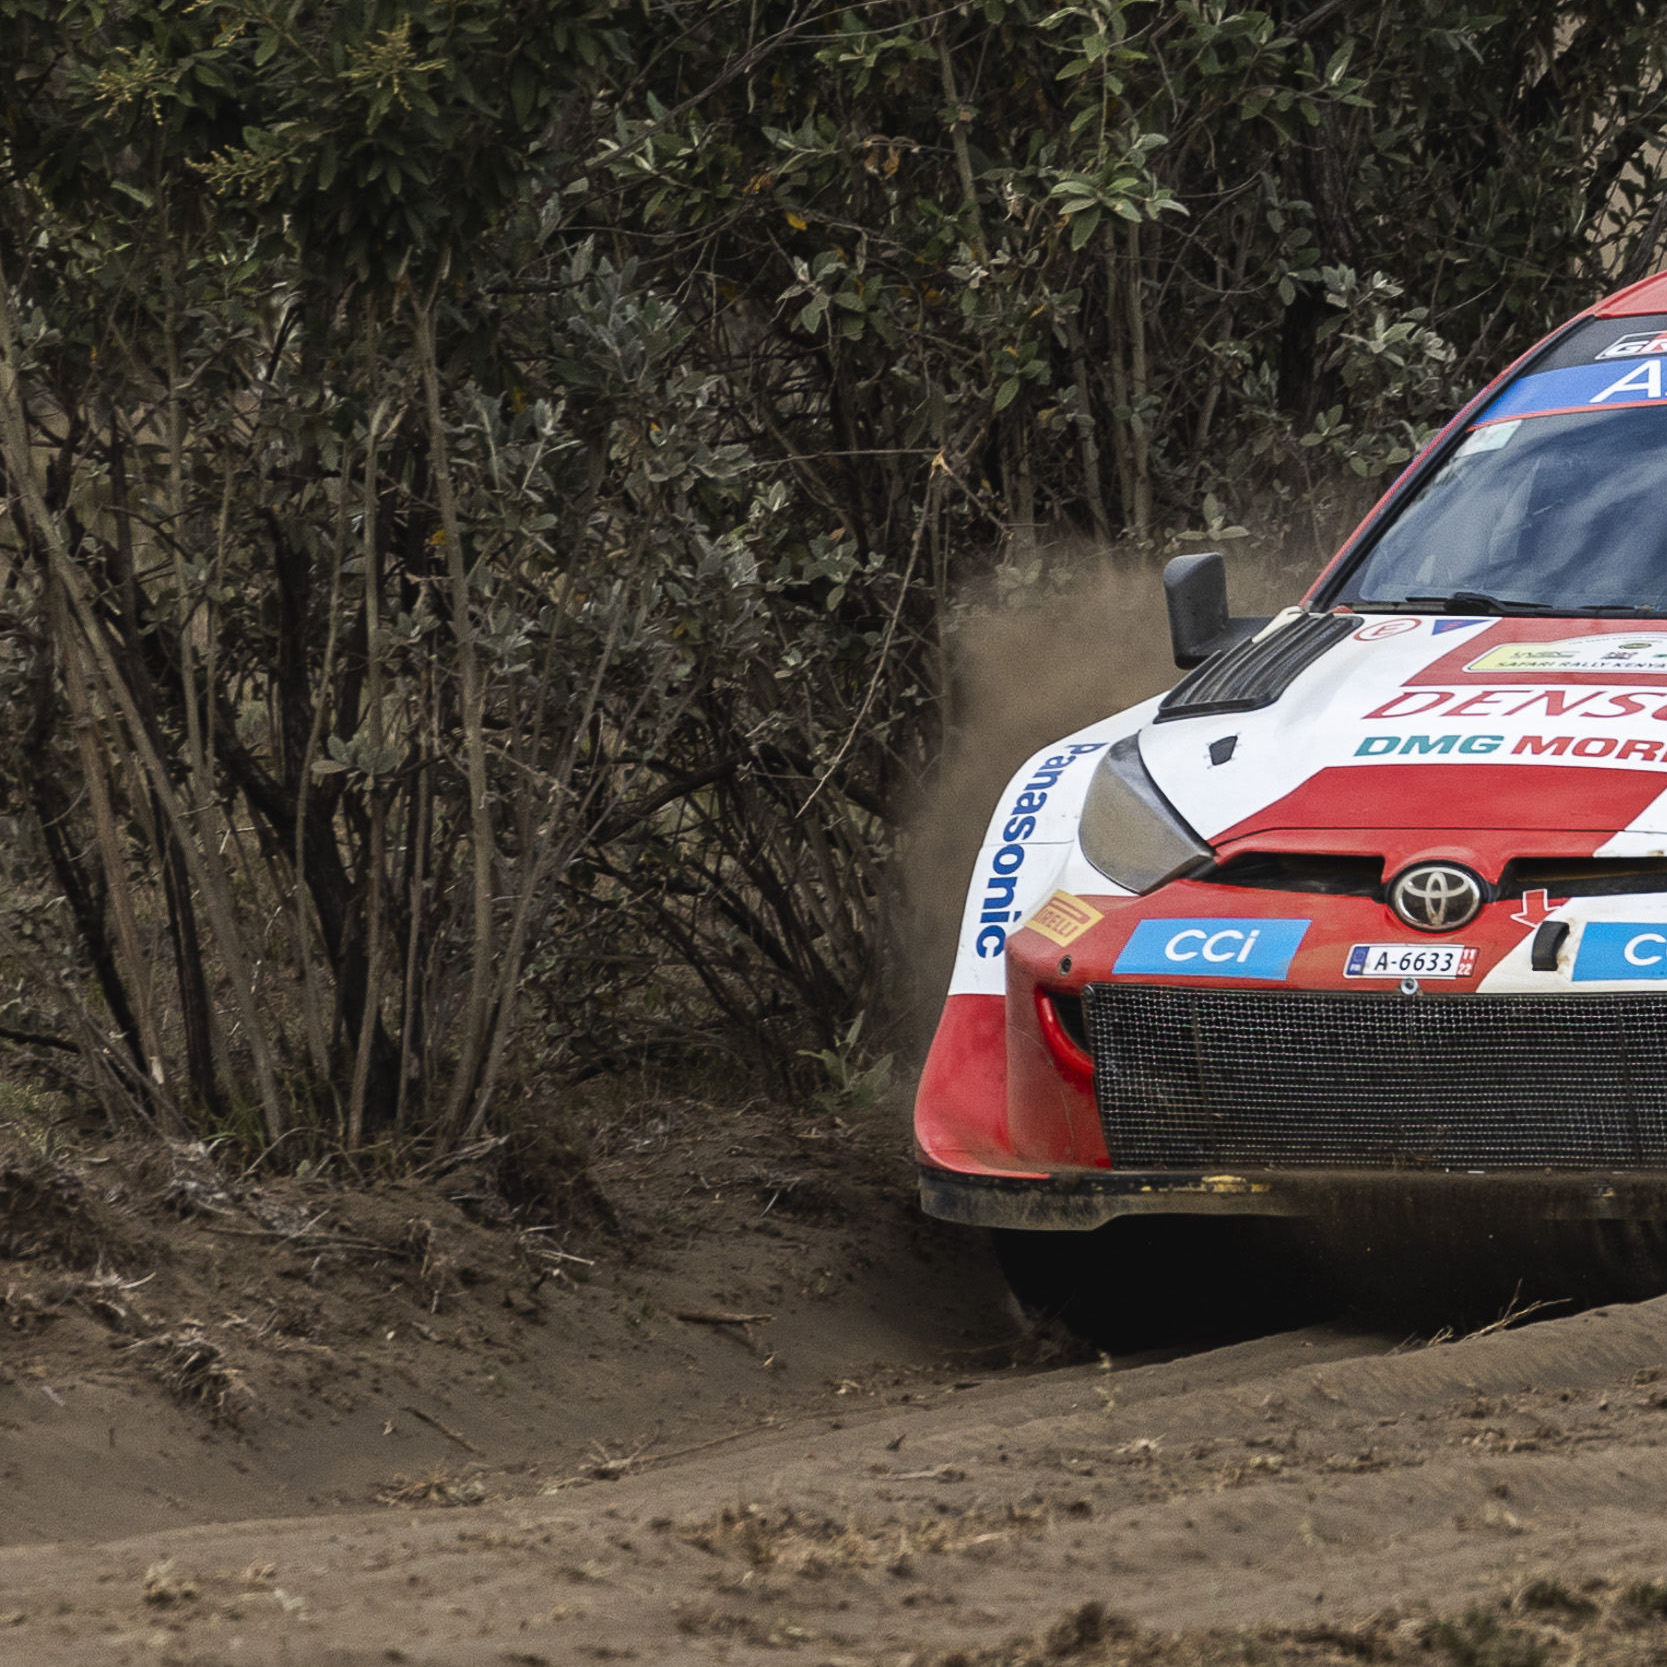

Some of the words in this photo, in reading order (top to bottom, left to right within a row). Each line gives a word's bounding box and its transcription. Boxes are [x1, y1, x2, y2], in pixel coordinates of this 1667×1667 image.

[1495, 661, 1556, 669] SAFARI
[1560, 661, 1611, 669] RALLY
[1612, 661, 1667, 669] KENYA
[1353, 734, 1505, 757] DMG
[976, 741, 1110, 959] Panasonic
[1373, 951, 1454, 972] A-6633
[1462, 948, 1477, 960] 11
[1457, 963, 1472, 975] 22
